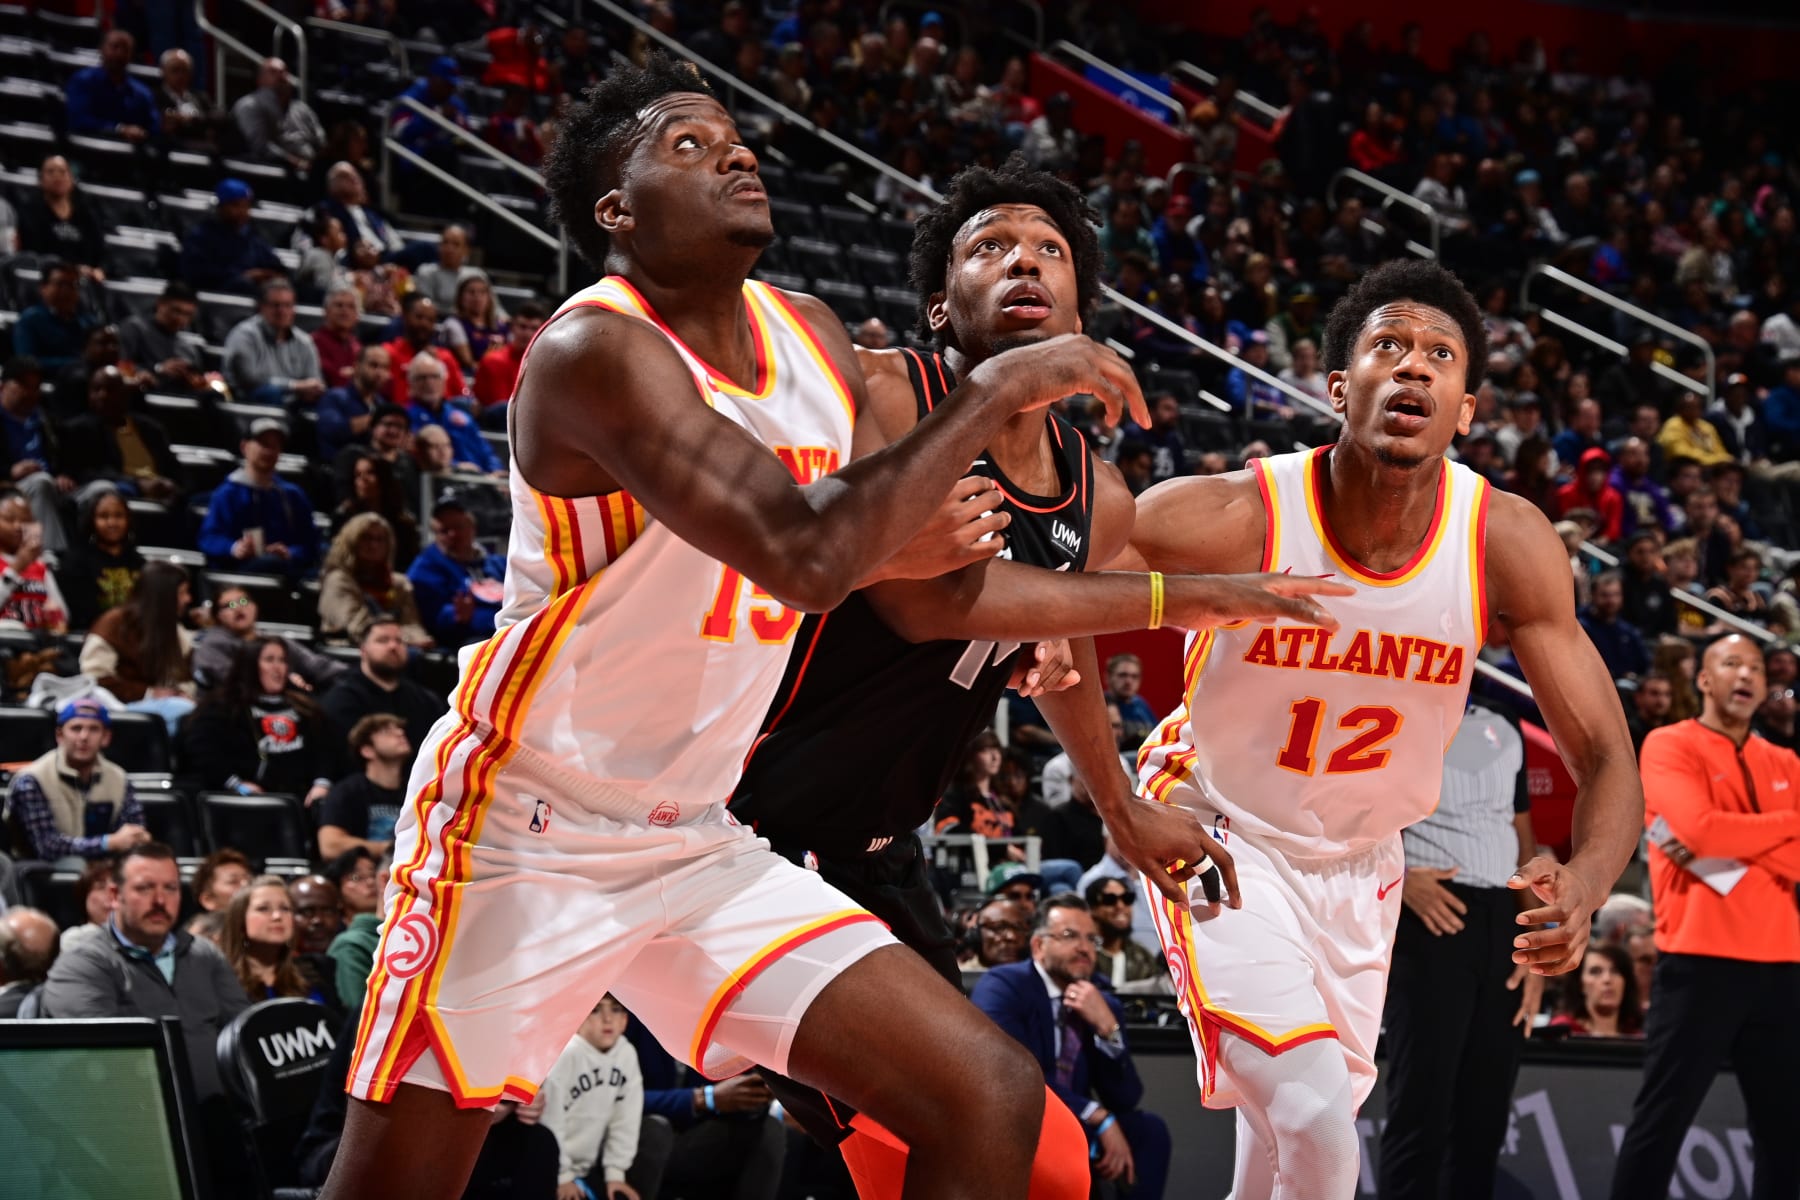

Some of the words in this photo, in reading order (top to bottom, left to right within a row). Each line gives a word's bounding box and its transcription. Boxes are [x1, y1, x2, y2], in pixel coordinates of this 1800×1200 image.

[1052, 519, 1082, 553] UWM
[1243, 626, 1465, 685] ATLANTA
[1276, 696, 1404, 776] 12
[648, 809, 681, 825] HAWKS
[258, 1019, 337, 1067] UWM
